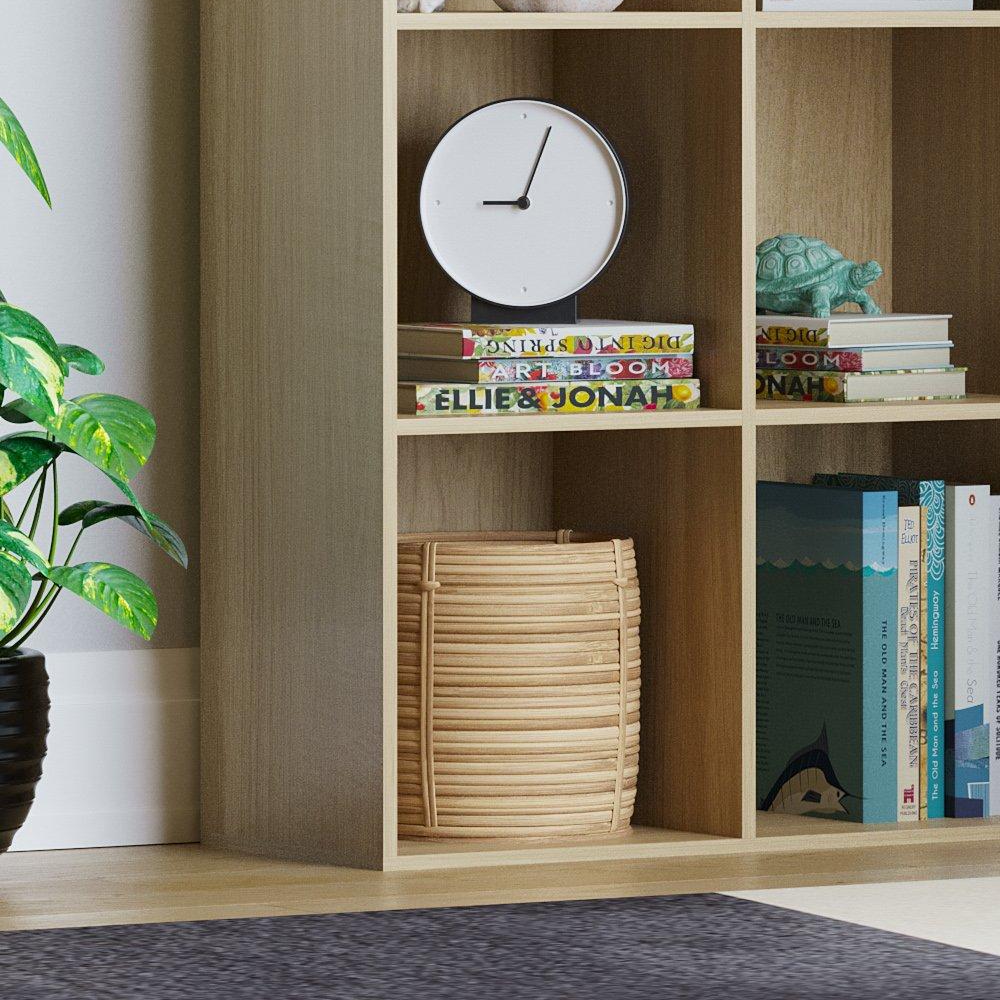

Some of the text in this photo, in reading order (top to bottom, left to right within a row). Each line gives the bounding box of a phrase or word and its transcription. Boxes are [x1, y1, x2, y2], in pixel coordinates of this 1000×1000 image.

[487, 338, 568, 354] SPRING
[643, 335, 681, 350] DIG
[786, 328, 818, 343] DIG
[491, 360, 670, 380] ART BLOOM
[434, 388, 511, 411] ELLIE
[551, 385, 674, 409] JONAH
[906, 559, 919, 620] PIRATES
[931, 590, 941, 650] Hemingway
[966, 678, 978, 704] Sea
[931, 670, 939, 801] The Old Man and the Sea
[880, 746, 888, 768] SEA
